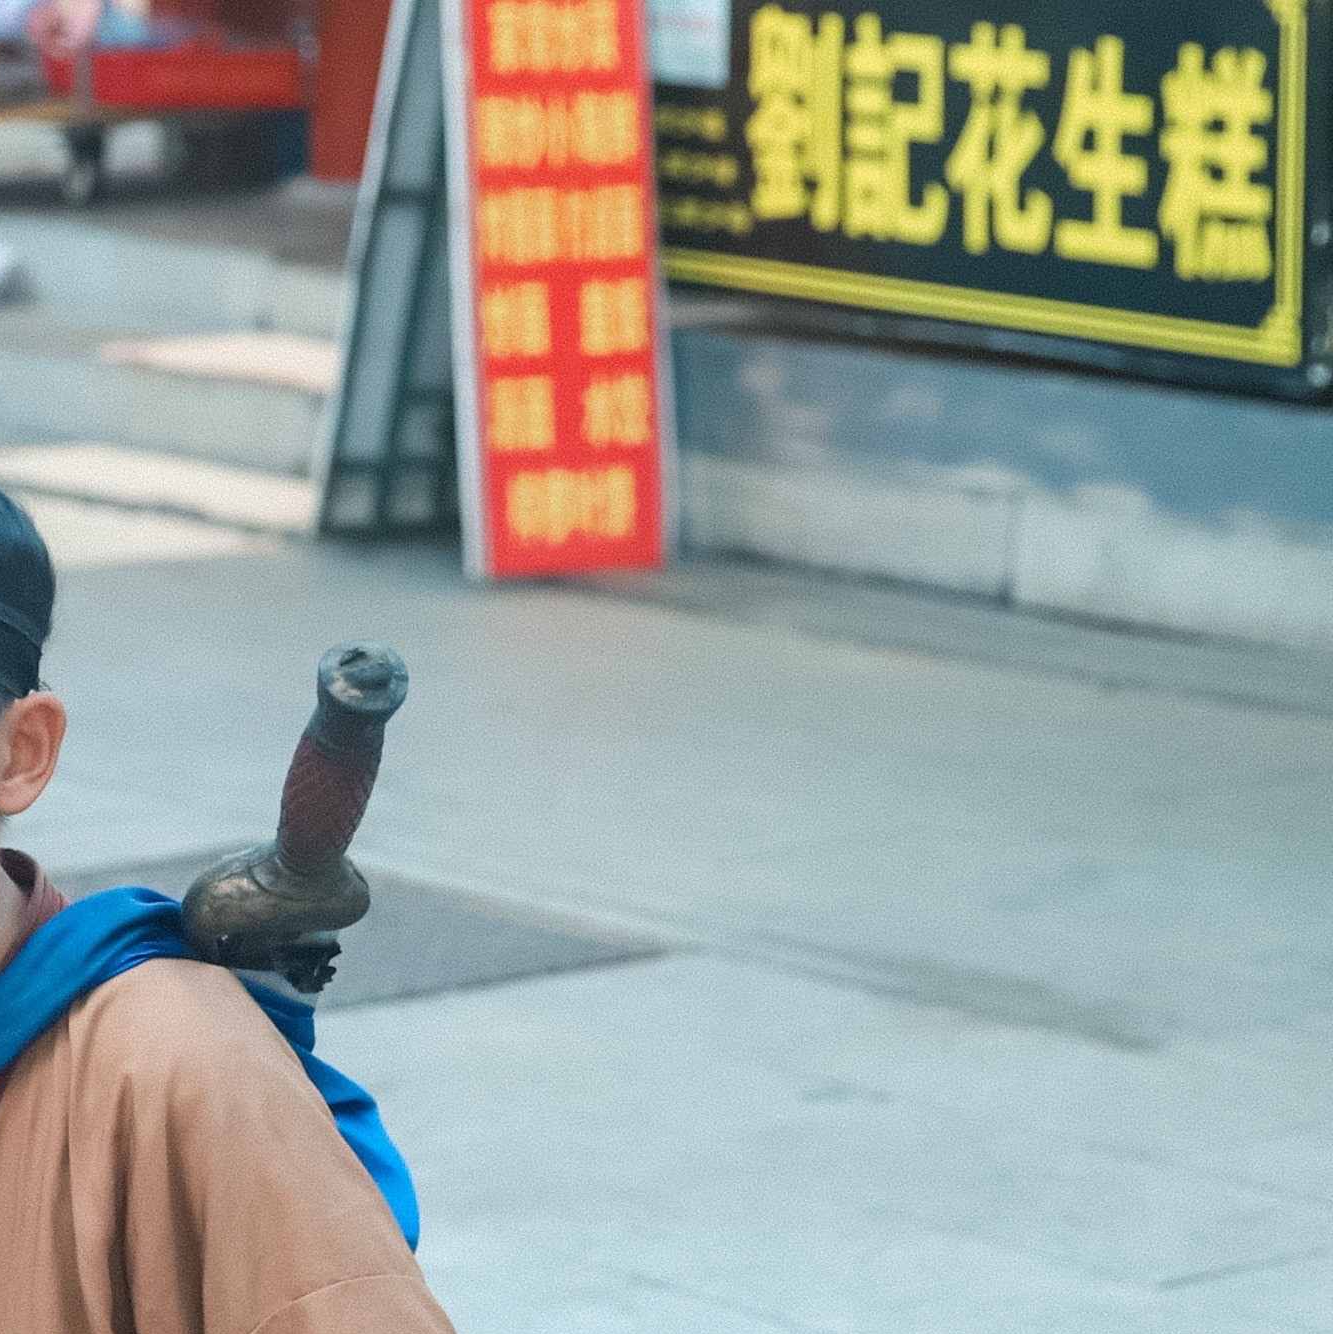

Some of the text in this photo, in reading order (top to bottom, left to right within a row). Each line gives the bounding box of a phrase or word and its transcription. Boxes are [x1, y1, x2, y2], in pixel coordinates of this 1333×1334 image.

[746, 5, 1272, 280] 劉記花生糕
